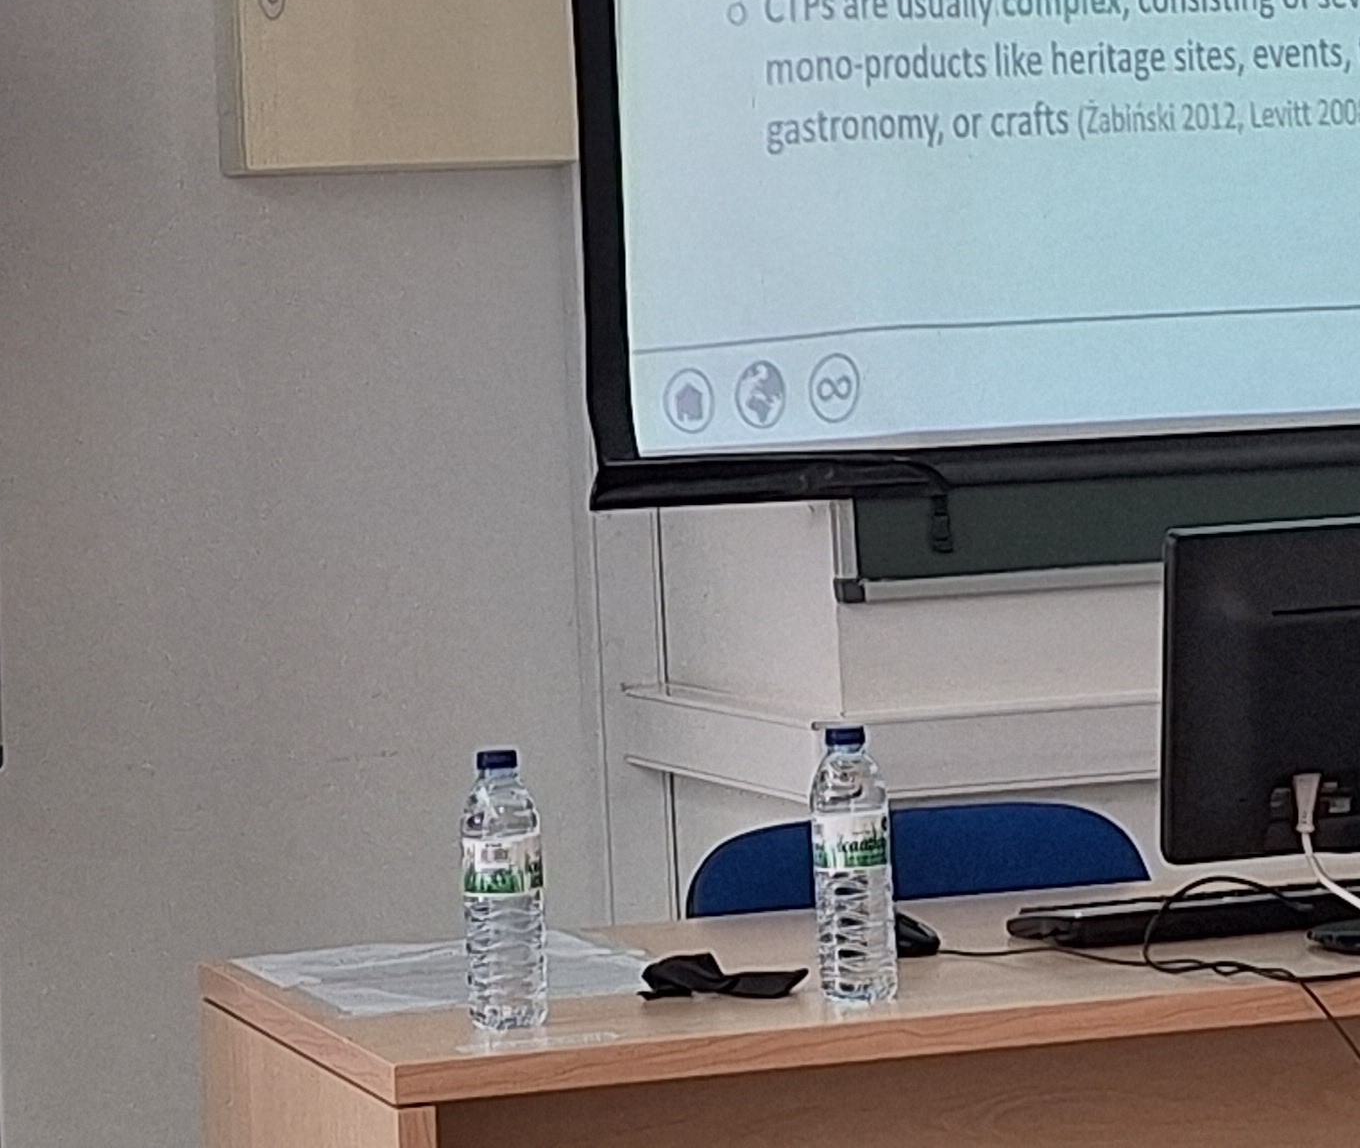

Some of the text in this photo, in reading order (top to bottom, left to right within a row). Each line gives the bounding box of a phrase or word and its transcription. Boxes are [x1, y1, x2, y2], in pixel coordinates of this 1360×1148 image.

[766, 43, 988, 88] mono-products
[994, 41, 1043, 78] like
[1050, 40, 1166, 82] heritage
[1174, 39, 1245, 77] sites,
[1253, 38, 1352, 74] events,
[767, 111, 945, 156] gastronomy,
[952, 112, 983, 139] or
[990, 100, 1070, 138] crafts
[1181, 101, 1245, 134] 2012,
[1249, 99, 1312, 129] Levitt
